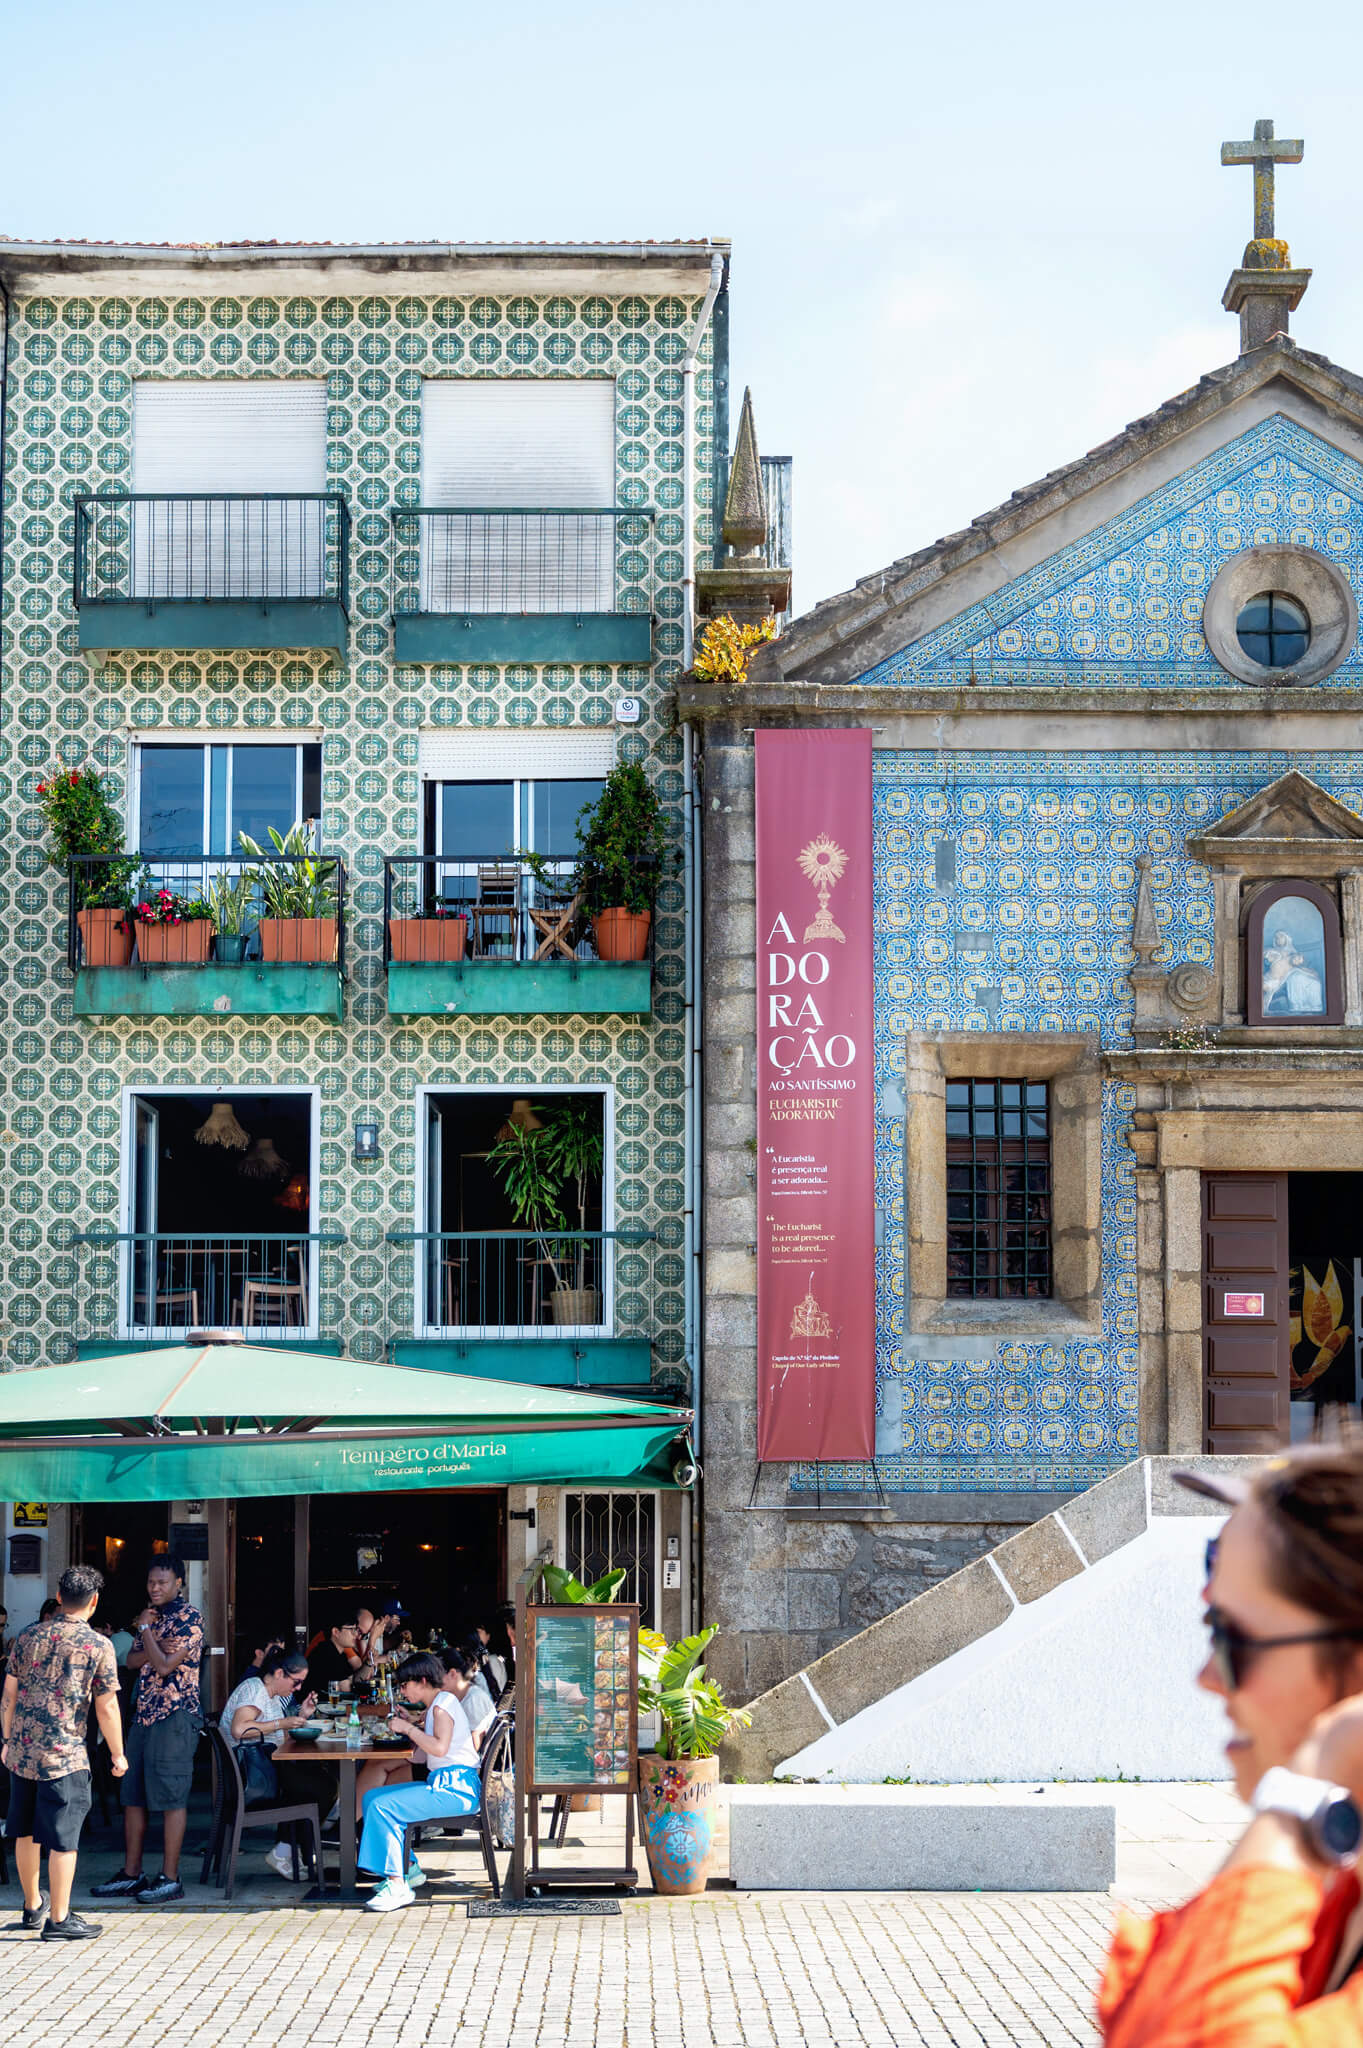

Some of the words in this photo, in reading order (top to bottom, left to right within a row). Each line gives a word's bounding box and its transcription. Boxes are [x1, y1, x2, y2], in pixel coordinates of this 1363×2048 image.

[766, 911, 797, 945] A
[768, 952, 830, 986] DO
[769, 993, 825, 1028] RA
[768, 1027, 857, 1077] ÇÃO
[768, 1080, 785, 1092] AO
[786, 1077, 856, 1091] SANTÍSSIMO
[769, 1097, 843, 1110] EUCHARISTIC
[769, 1109, 835, 1121] ADORATION
[772, 1155, 778, 1163] A
[778, 1154, 816, 1163] Eucaristia
[771, 1166, 777, 1174] é
[777, 1166, 812, 1175] presença
[812, 1164, 828, 1173] real
[772, 1223, 786, 1231] The
[787, 1223, 822, 1231] Eucharist
[785, 1233, 800, 1241] real
[800, 1234, 836, 1243] presence
[781, 1244, 791, 1252] be
[374, 1466, 424, 1477] restaurante
[427, 1462, 471, 1476] português
